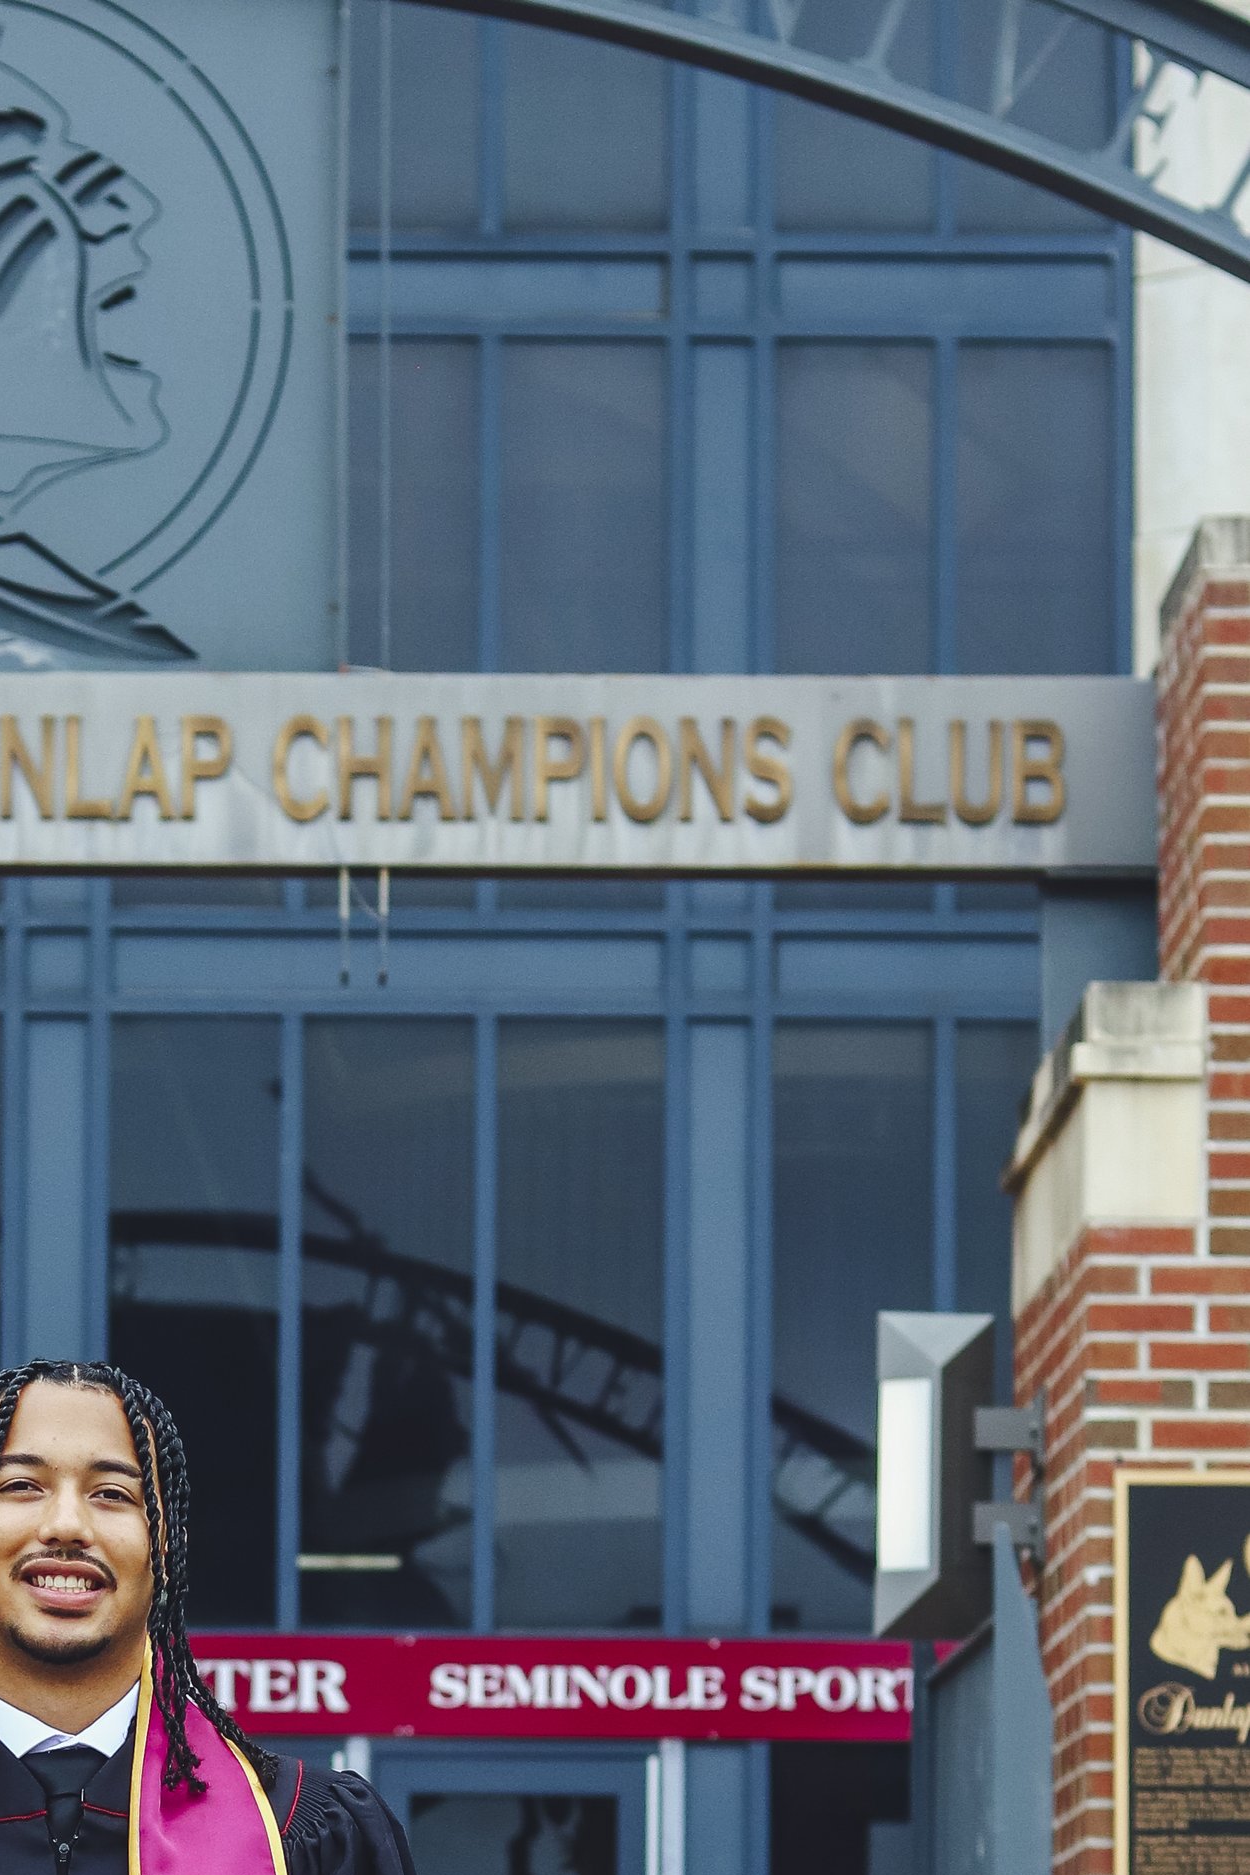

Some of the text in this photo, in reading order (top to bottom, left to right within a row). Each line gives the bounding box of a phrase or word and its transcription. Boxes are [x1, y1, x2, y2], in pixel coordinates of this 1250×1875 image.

[271, 713, 794, 824] CHAMPIONS
[832, 717, 1068, 826] CLUB
[429, 1663, 727, 1711] SEMINOLE
